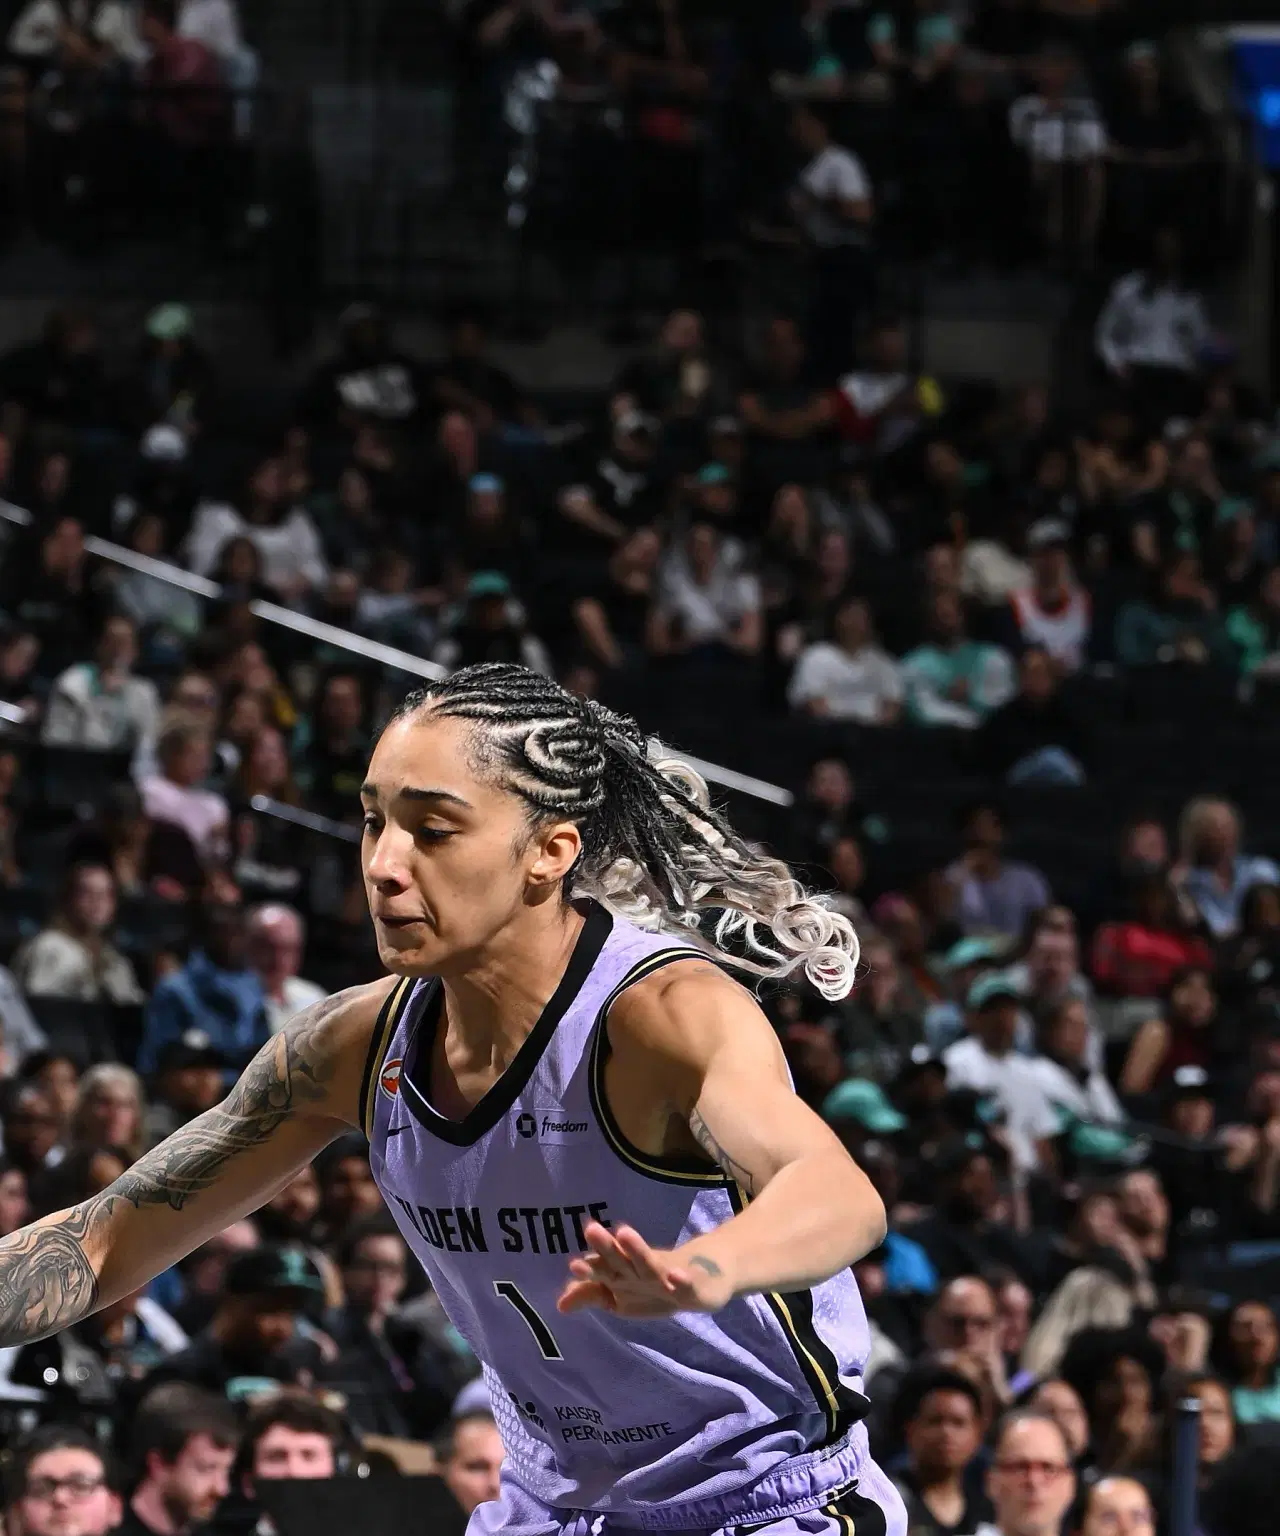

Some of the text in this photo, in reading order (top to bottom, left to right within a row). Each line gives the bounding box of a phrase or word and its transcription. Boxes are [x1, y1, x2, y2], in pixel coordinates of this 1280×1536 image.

[541, 1116, 588, 1136] freedom
[493, 1280, 564, 1361] 1
[554, 1406, 604, 1425] KAISER
